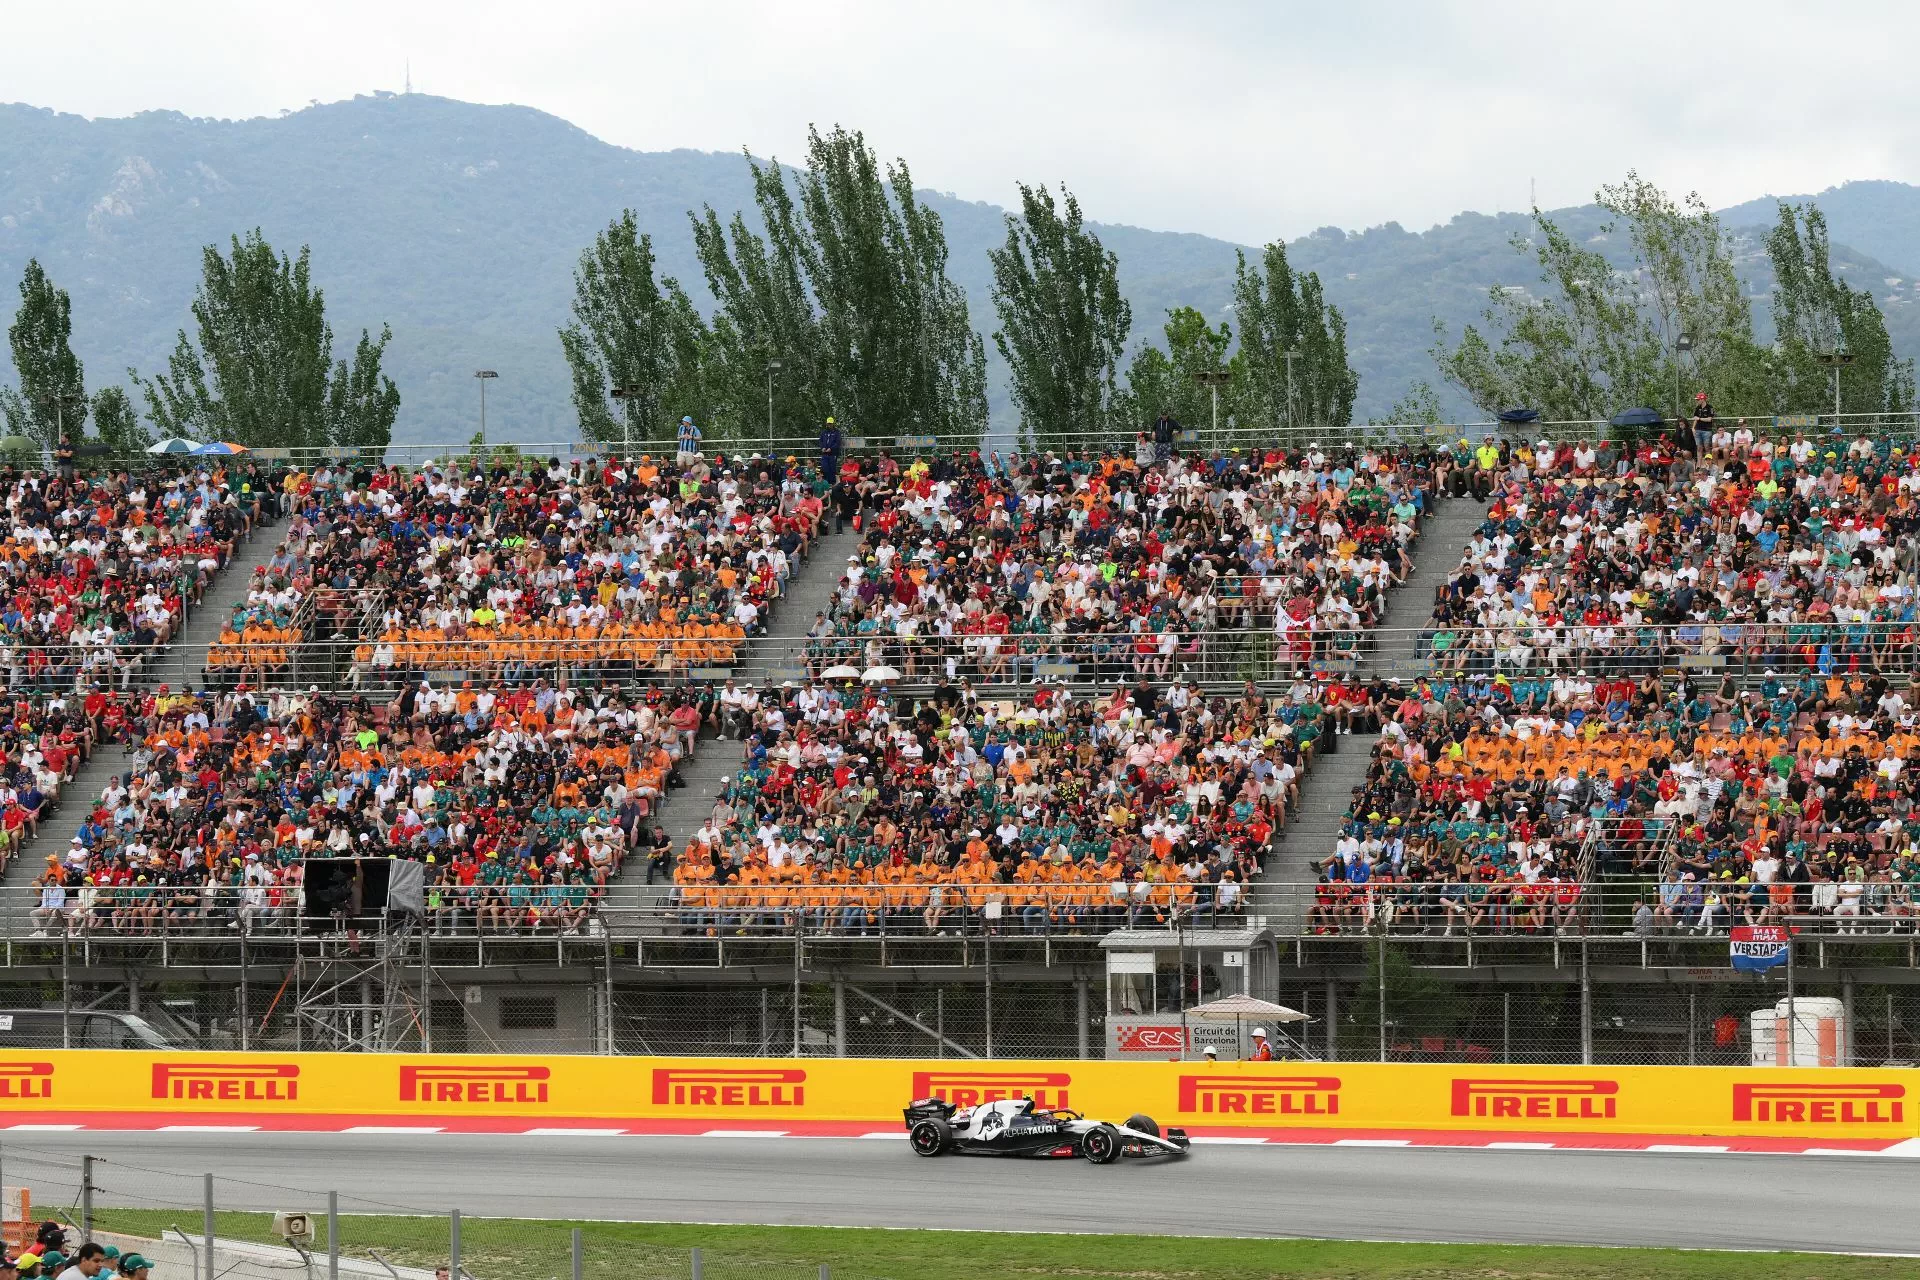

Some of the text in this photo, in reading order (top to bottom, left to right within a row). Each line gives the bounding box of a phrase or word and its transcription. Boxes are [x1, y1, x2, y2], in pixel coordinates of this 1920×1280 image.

[1777, 416, 1807, 427] ZONA
[574, 444, 599, 453] ZONA
[1325, 661, 1347, 671] ZONA
[428, 671, 454, 681] ZONA
[1753, 929, 1778, 940] MAX
[1194, 1027, 1236, 1035] Circuit de
[152, 1063, 300, 1100] PIRELLI
[400, 1066, 551, 1102] PIRELLI
[652, 1069, 806, 1106] PIRELLI
[1179, 1075, 1342, 1114] PIRELLI
[1451, 1079, 1620, 1118] PIRELLI
[1733, 1083, 1906, 1122] PIRELLI
[1003, 1125, 1058, 1138] ALPHATAURI
